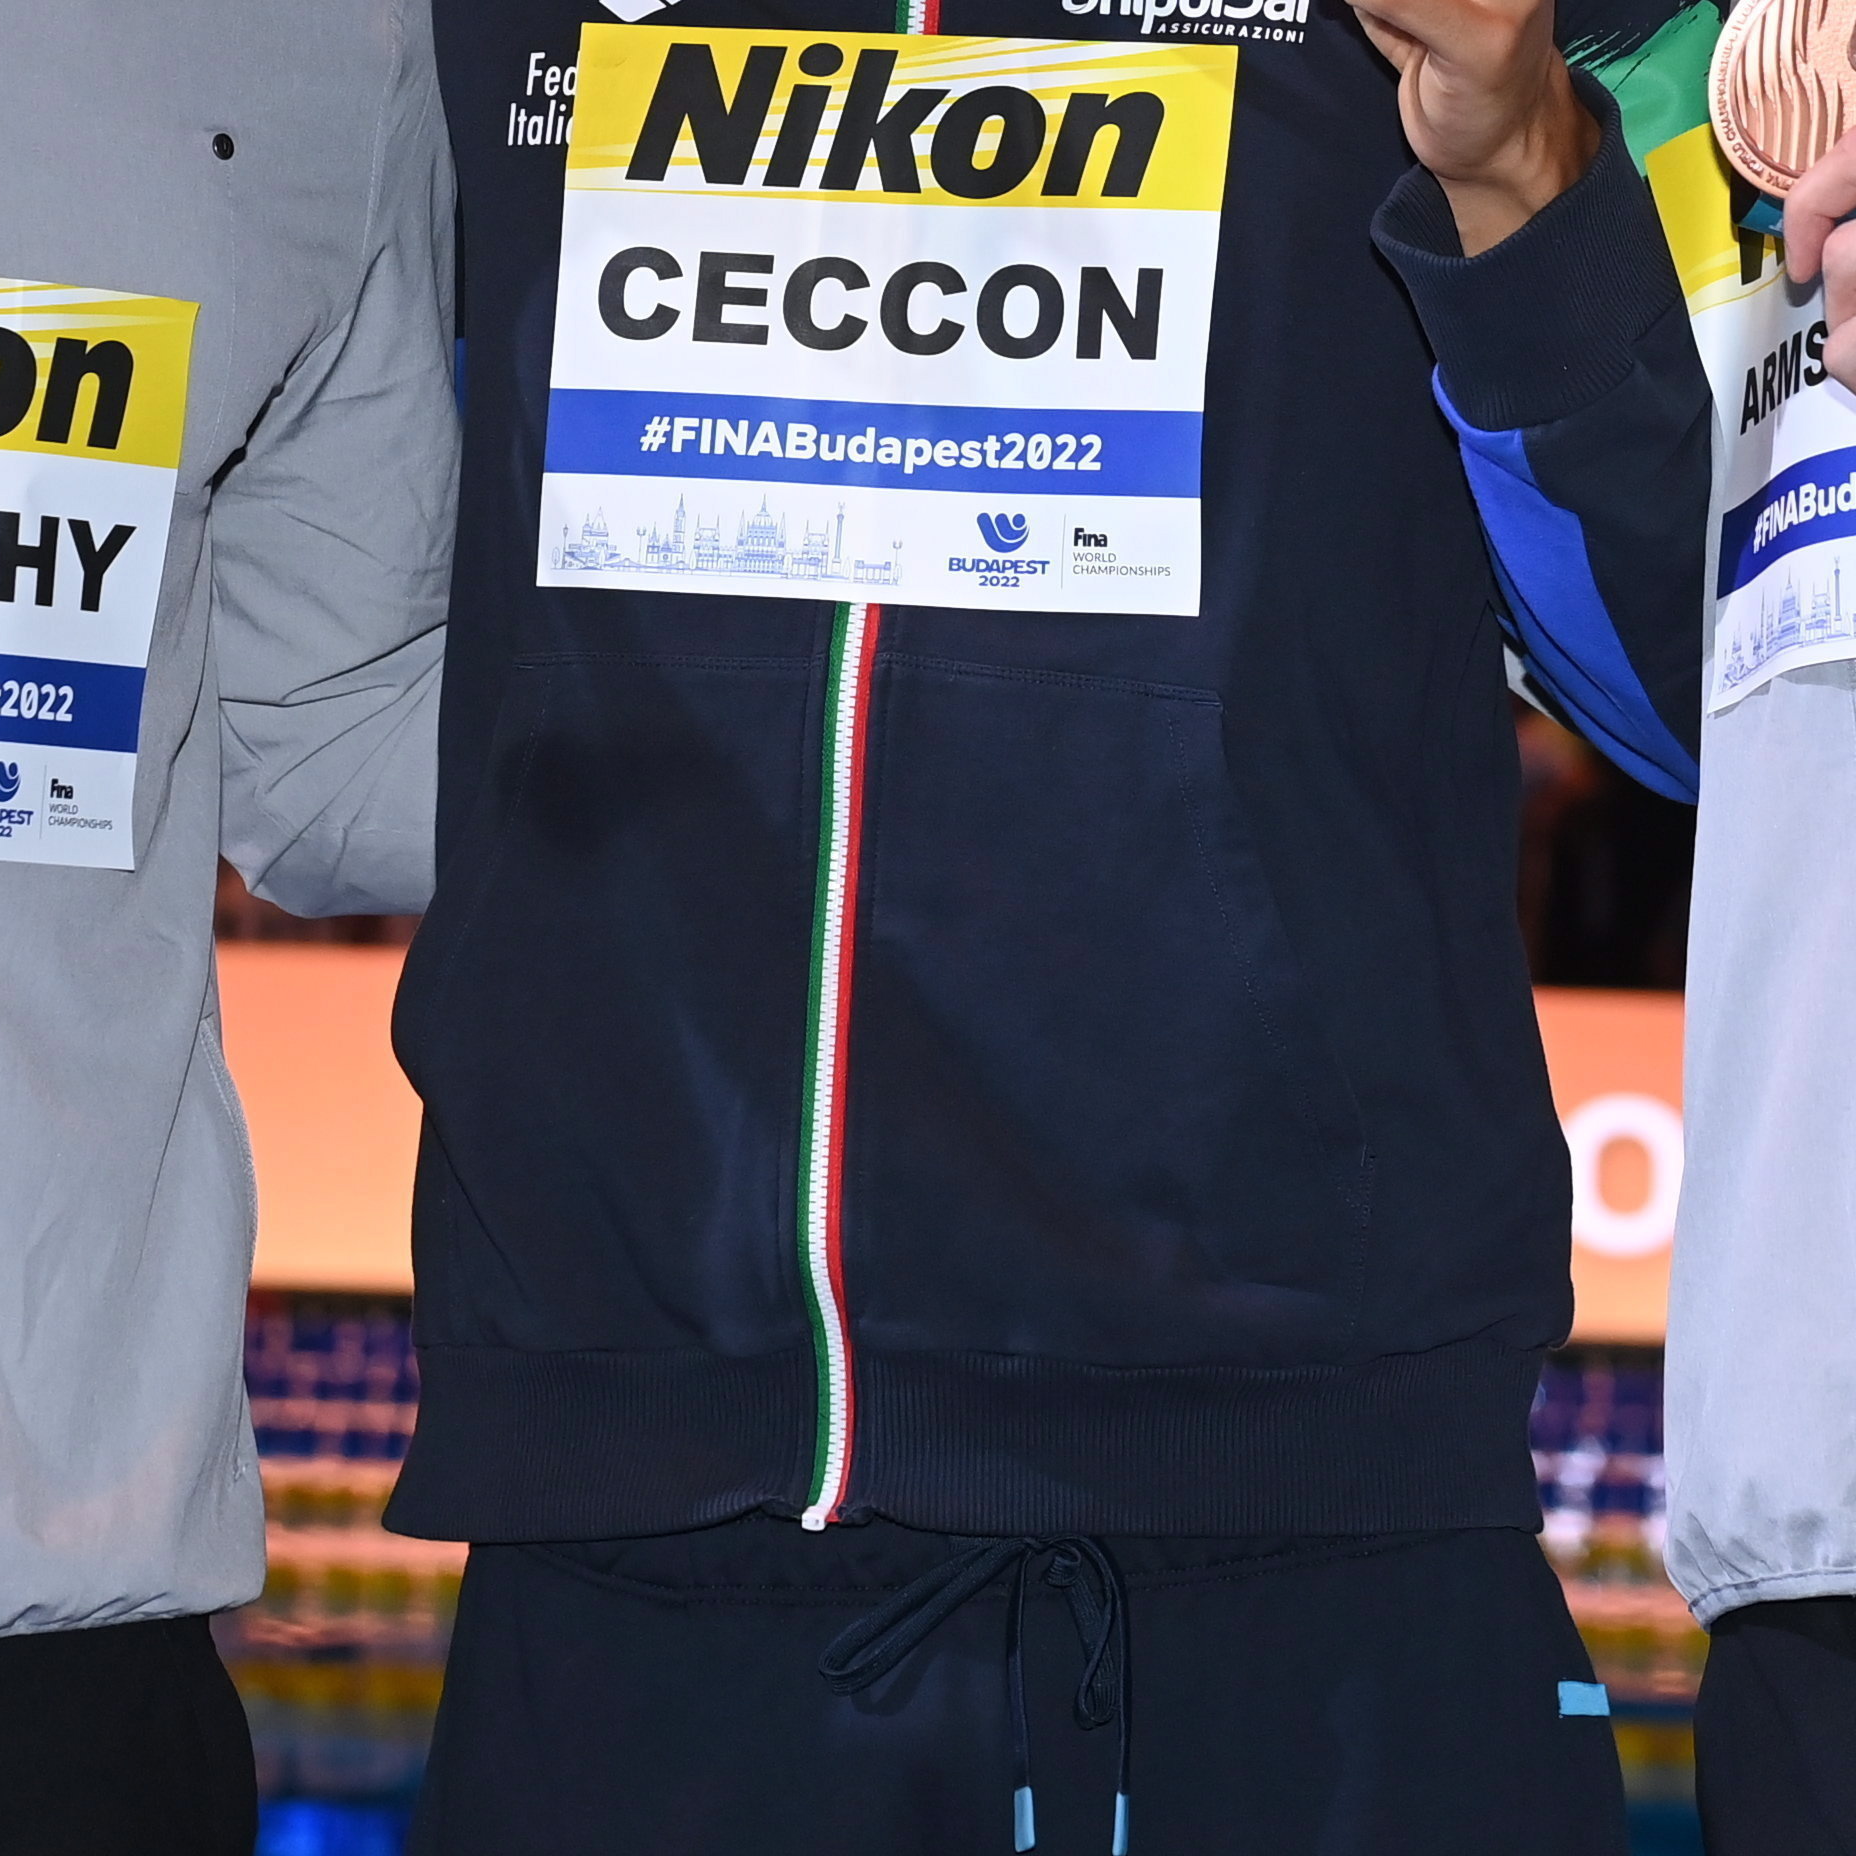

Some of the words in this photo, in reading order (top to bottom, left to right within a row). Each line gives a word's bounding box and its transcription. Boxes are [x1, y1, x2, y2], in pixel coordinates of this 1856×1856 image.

[1157, 23, 1305, 44] ASSICURAZIONI
[625, 42, 1165, 200] Nikon
[597, 246, 1164, 360] CECCON
[639, 415, 1103, 473] #FINABudapest2022
[1073, 527, 1108, 548] Fina
[948, 557, 1051, 575] BUDAPEST
[1072, 551, 1117, 563] WORLD
[1072, 564, 1171, 577] CHAMPIONSHIPS
[978, 574, 1020, 588] 2022
[50, 778, 74, 800] Fina
[48, 803, 79, 815] WORLD
[47, 816, 113, 831] CHAMPIONSHIPS
